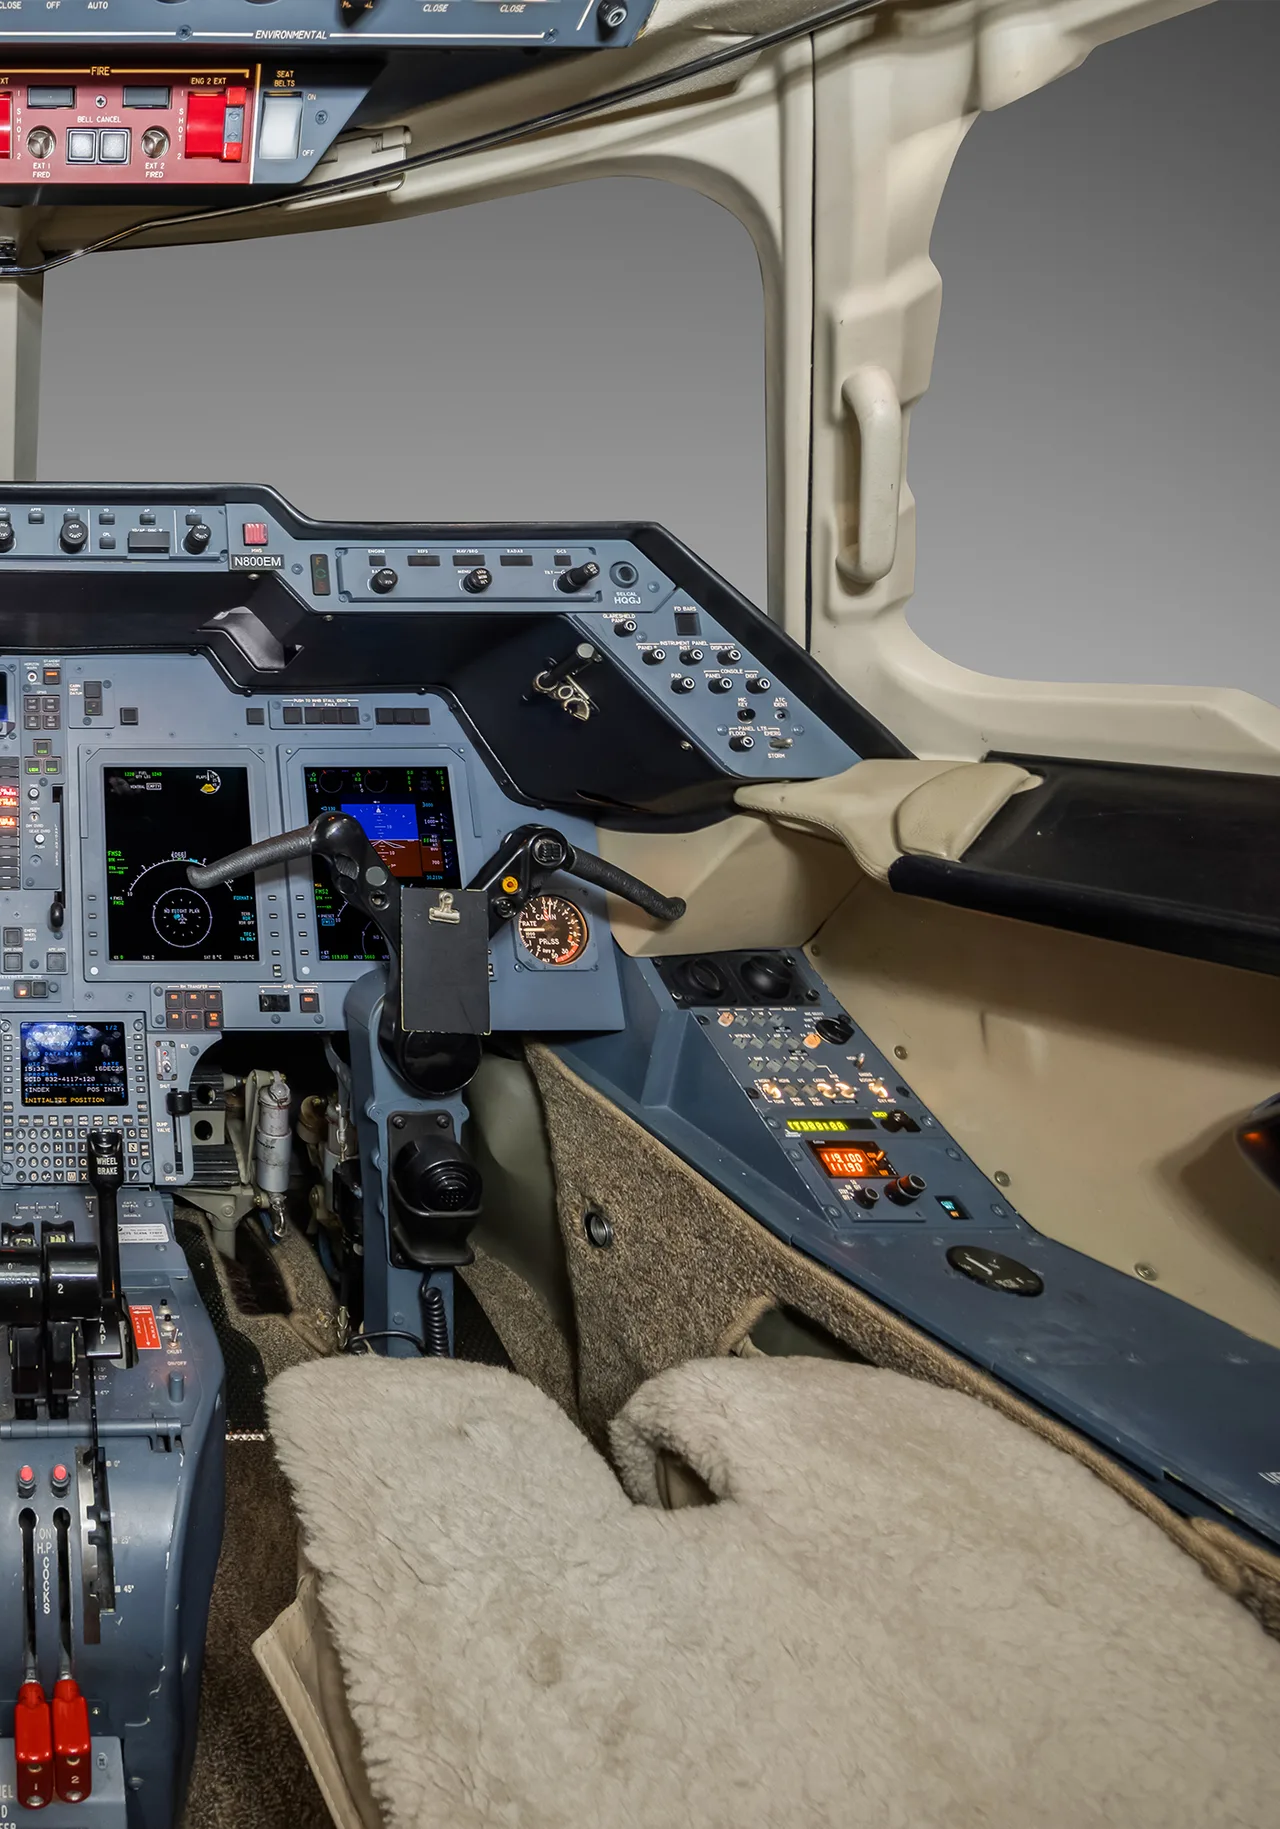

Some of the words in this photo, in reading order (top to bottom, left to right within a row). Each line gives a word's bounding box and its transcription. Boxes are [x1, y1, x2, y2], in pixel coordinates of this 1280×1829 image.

[46, 1, 61, 10] OFF
[87, 1, 108, 10] AUTO
[422, 4, 449, 13] CLOSE
[499, 4, 526, 13] CLOSE
[254, 30, 328, 40] ENVIRONMENTAL
[91, 66, 110, 76] FIRE
[276, 70, 294, 78] SEAT
[191, 77, 204, 85] ENG
[213, 77, 226, 85] EXT
[274, 79, 296, 87] BELTS
[302, 149, 315, 157] OFF
[234, 556, 282, 567] N800EM
[614, 596, 641, 605] HQGJ
[96, 1157, 118, 1165] WHEEL
[97, 1167, 118, 1175] BRAKE
[57, 1284, 64, 1294] 2
[39, 1528, 51, 1539] ON
[37, 1543, 54, 1554] H.P.
[43, 1556, 51, 1614] COCKS
[71, 1776, 79, 1784] 2
